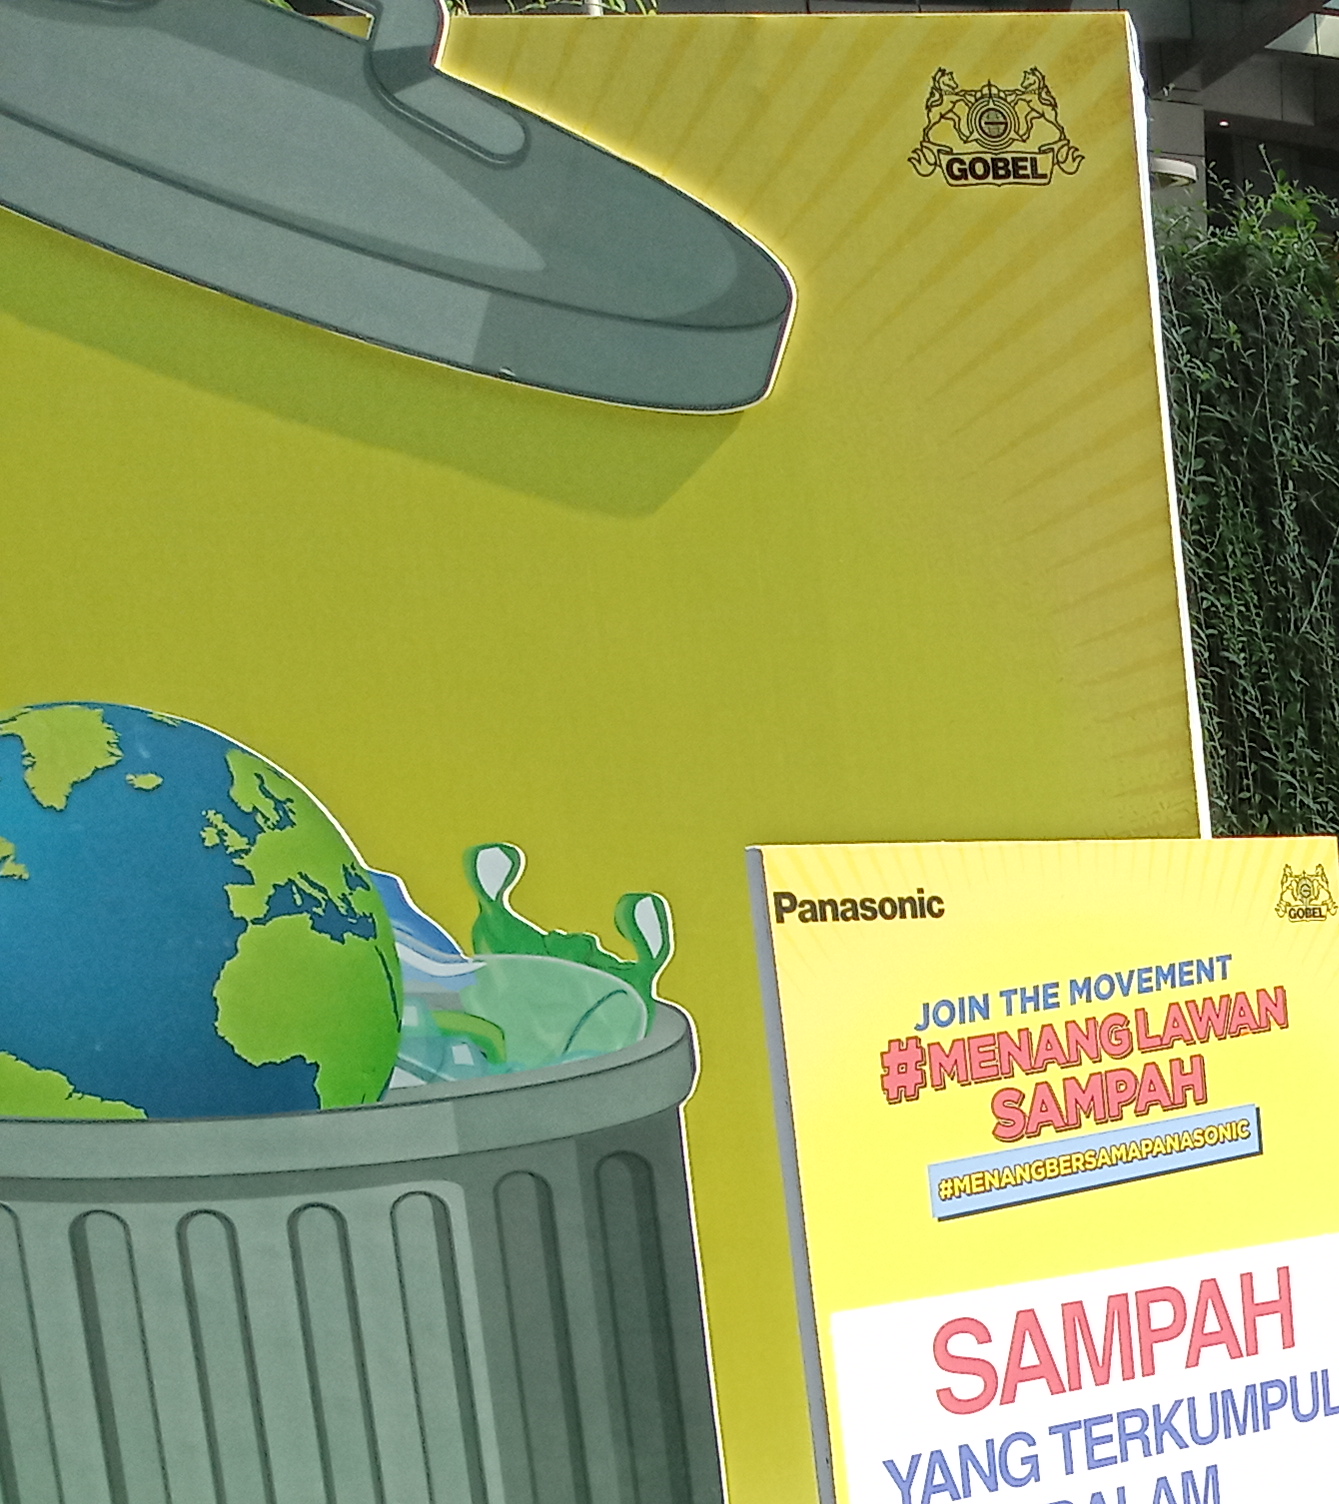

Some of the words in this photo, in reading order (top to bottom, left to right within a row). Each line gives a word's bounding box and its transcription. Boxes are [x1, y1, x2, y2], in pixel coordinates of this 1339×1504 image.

[945, 155, 1048, 181] GOBEL
[773, 887, 945, 924] Panasonic
[1288, 907, 1327, 920] GOBEL
[914, 993, 990, 1032] JOIN
[999, 982, 1063, 1018] THE
[1069, 954, 1233, 1005] MOVEMENT
[990, 1054, 1208, 1143] SAMPAH
[938, 1118, 1251, 1202] #MENANGBERSAMAPANASONIC
[931, 1265, 1297, 1416] SAMPAH
